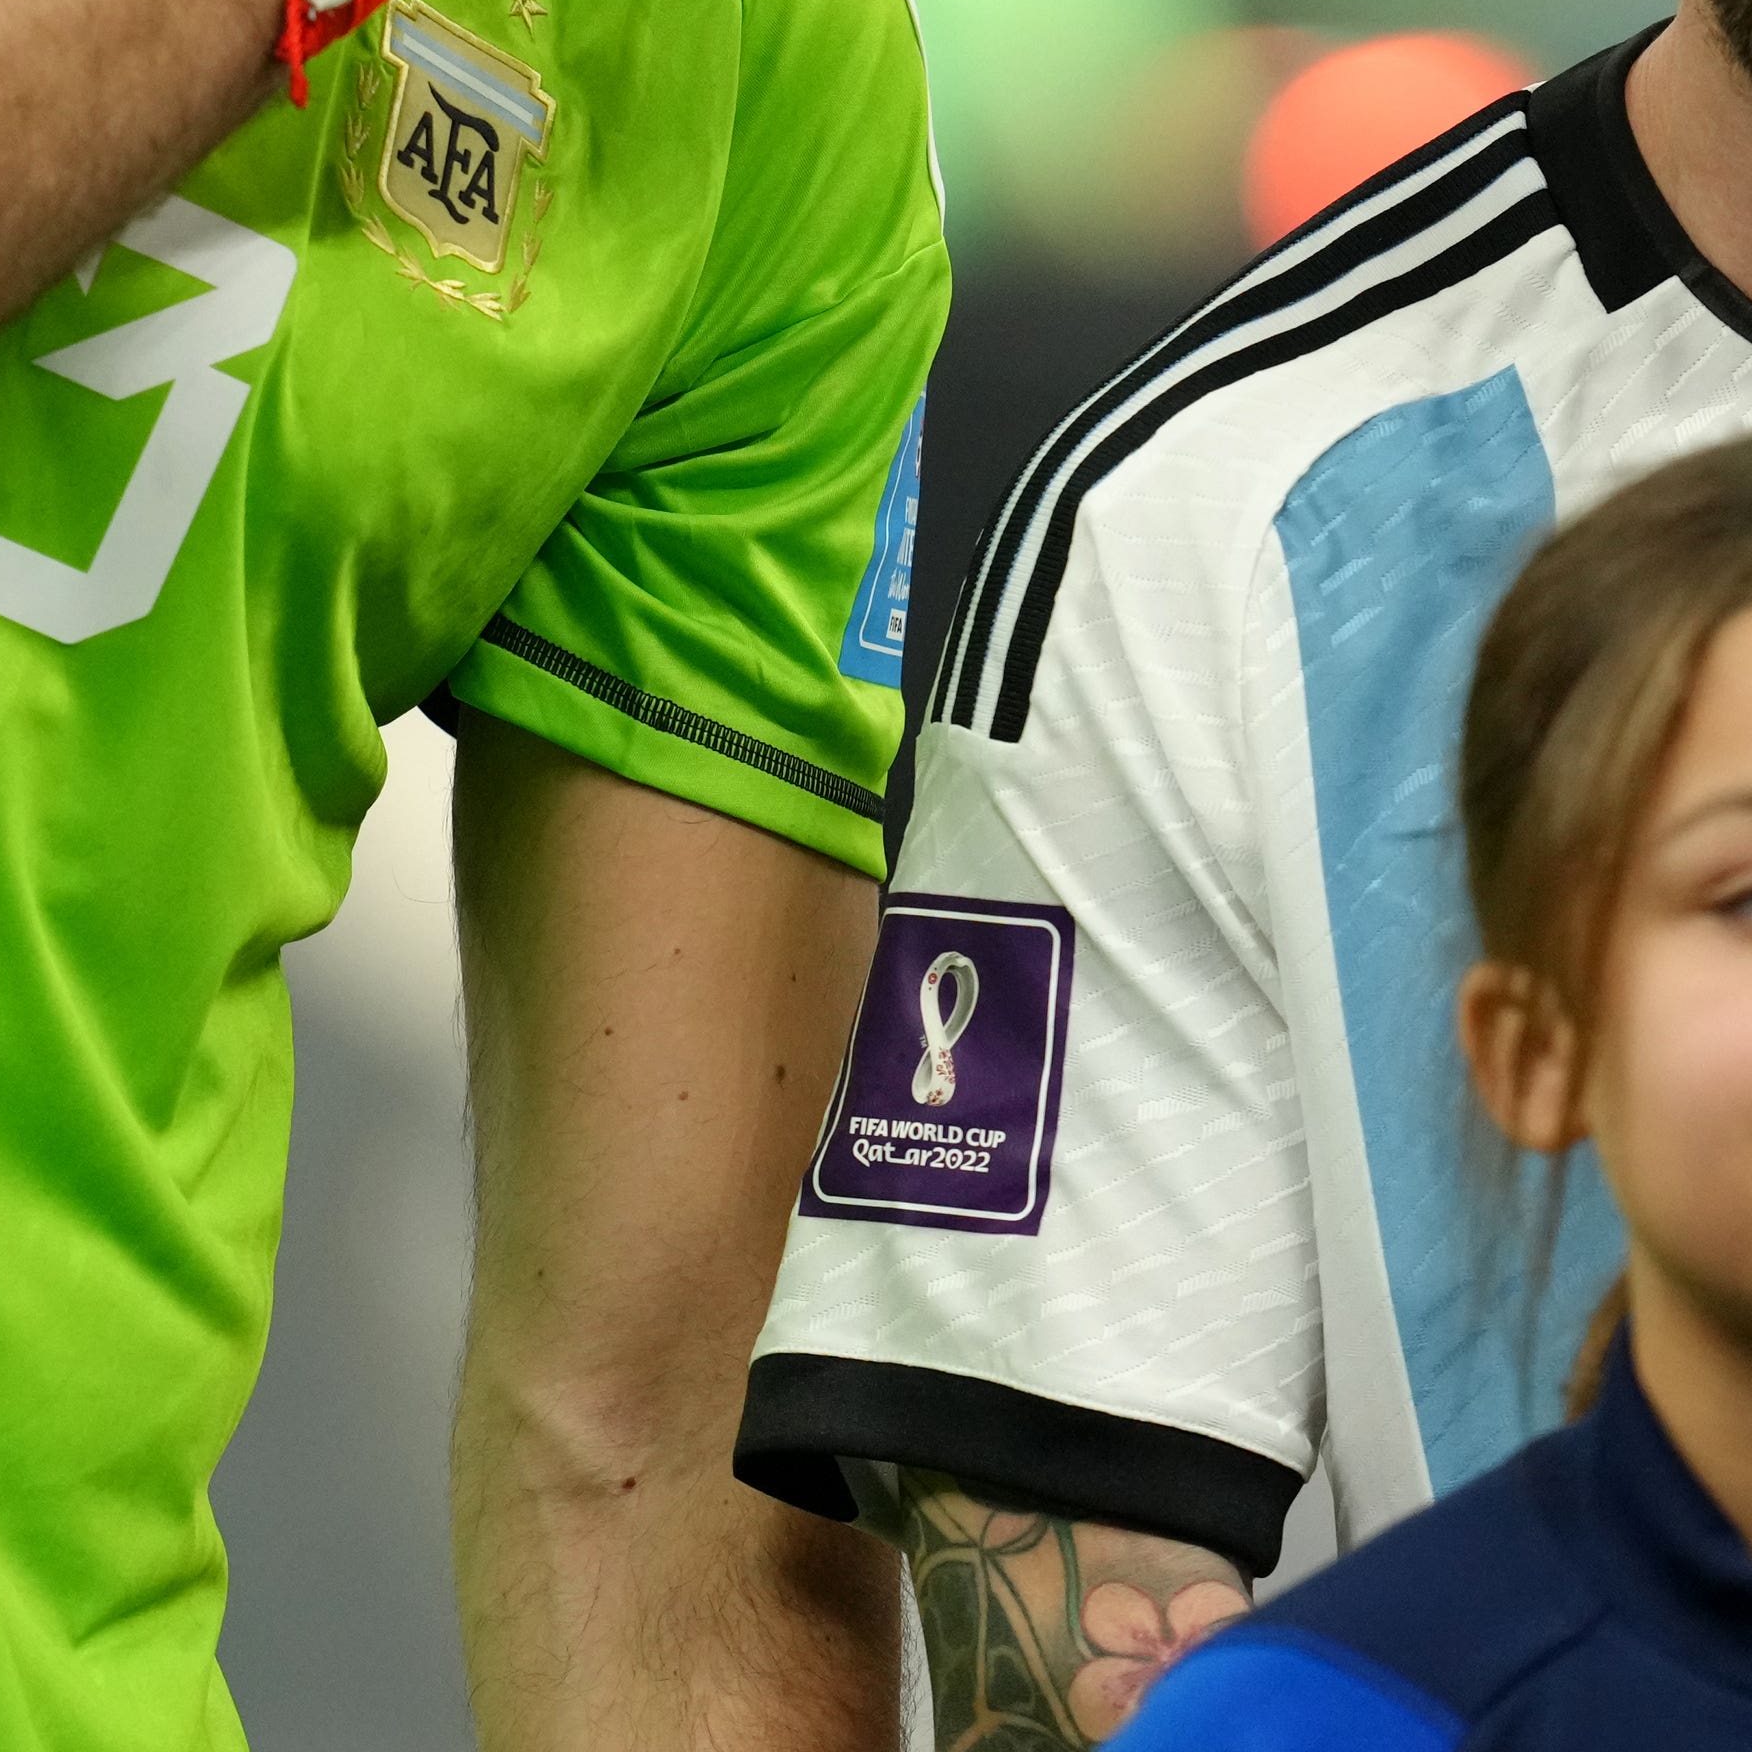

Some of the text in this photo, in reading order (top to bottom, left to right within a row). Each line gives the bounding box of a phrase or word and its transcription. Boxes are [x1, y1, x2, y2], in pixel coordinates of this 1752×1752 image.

[397, 81, 500, 225] AFA
[849, 1116, 1007, 1149] FIFA WORLD CUP
